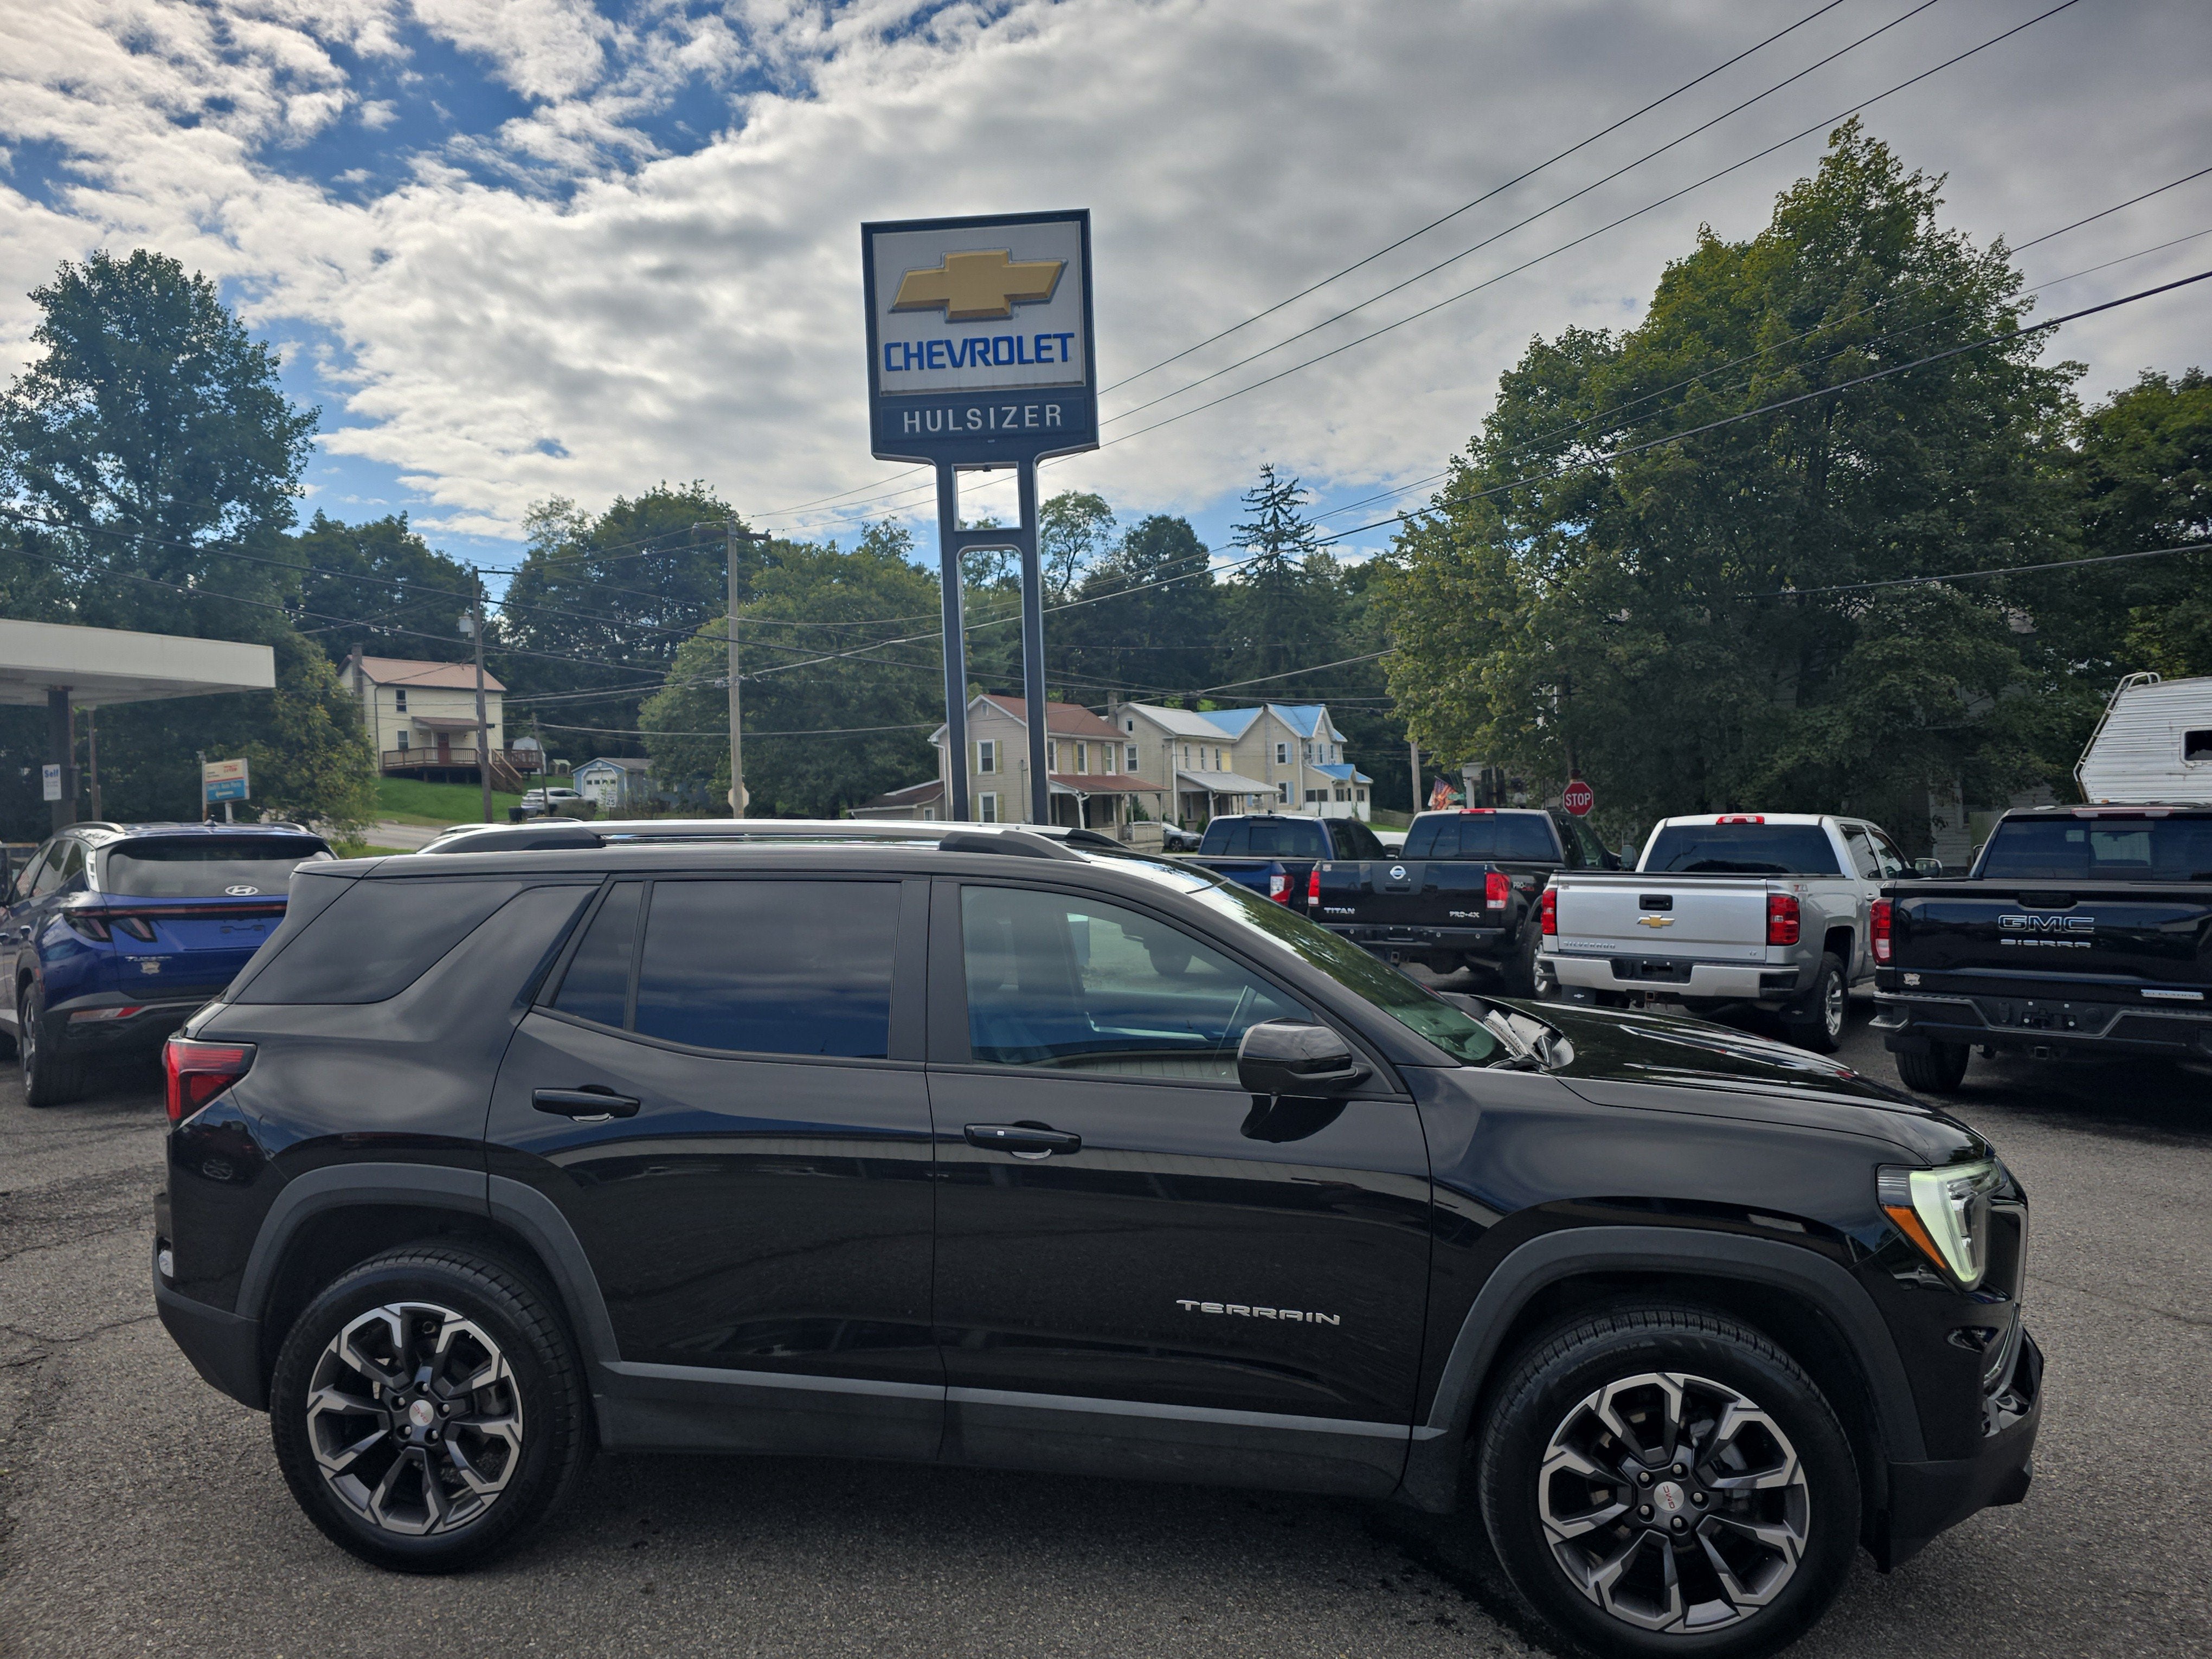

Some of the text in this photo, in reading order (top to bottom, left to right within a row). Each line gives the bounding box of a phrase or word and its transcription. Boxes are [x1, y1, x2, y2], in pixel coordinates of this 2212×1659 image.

[884, 332, 1075, 371] CHEVROLET
[903, 404, 1062, 434] HULSIZER
[1565, 793, 1591, 807] STOP
[1998, 915, 2095, 933] GMC
[2000, 939, 2091, 948] SIERRA
[1176, 1300, 1340, 1326] TERRAIN
[1663, 1486, 1675, 1509] GMC
